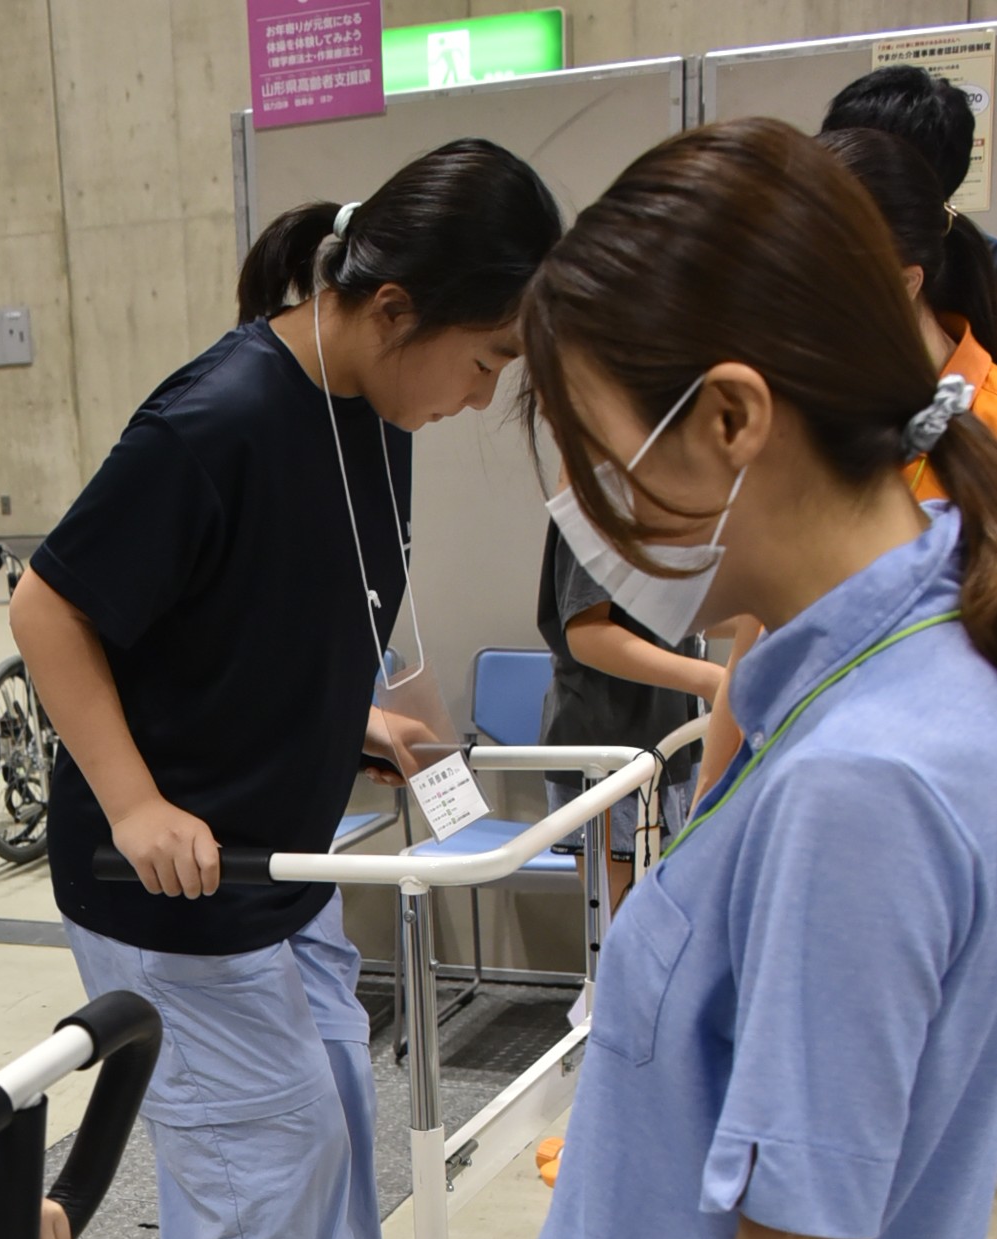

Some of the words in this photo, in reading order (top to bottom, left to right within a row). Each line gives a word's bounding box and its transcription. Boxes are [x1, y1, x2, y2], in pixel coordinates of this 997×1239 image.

[266, 13, 362, 38] お年寄りが元気になる
[266, 30, 362, 54] 体操を体験してみよう
[261, 68, 372, 98] 山形県高齢者支援課
